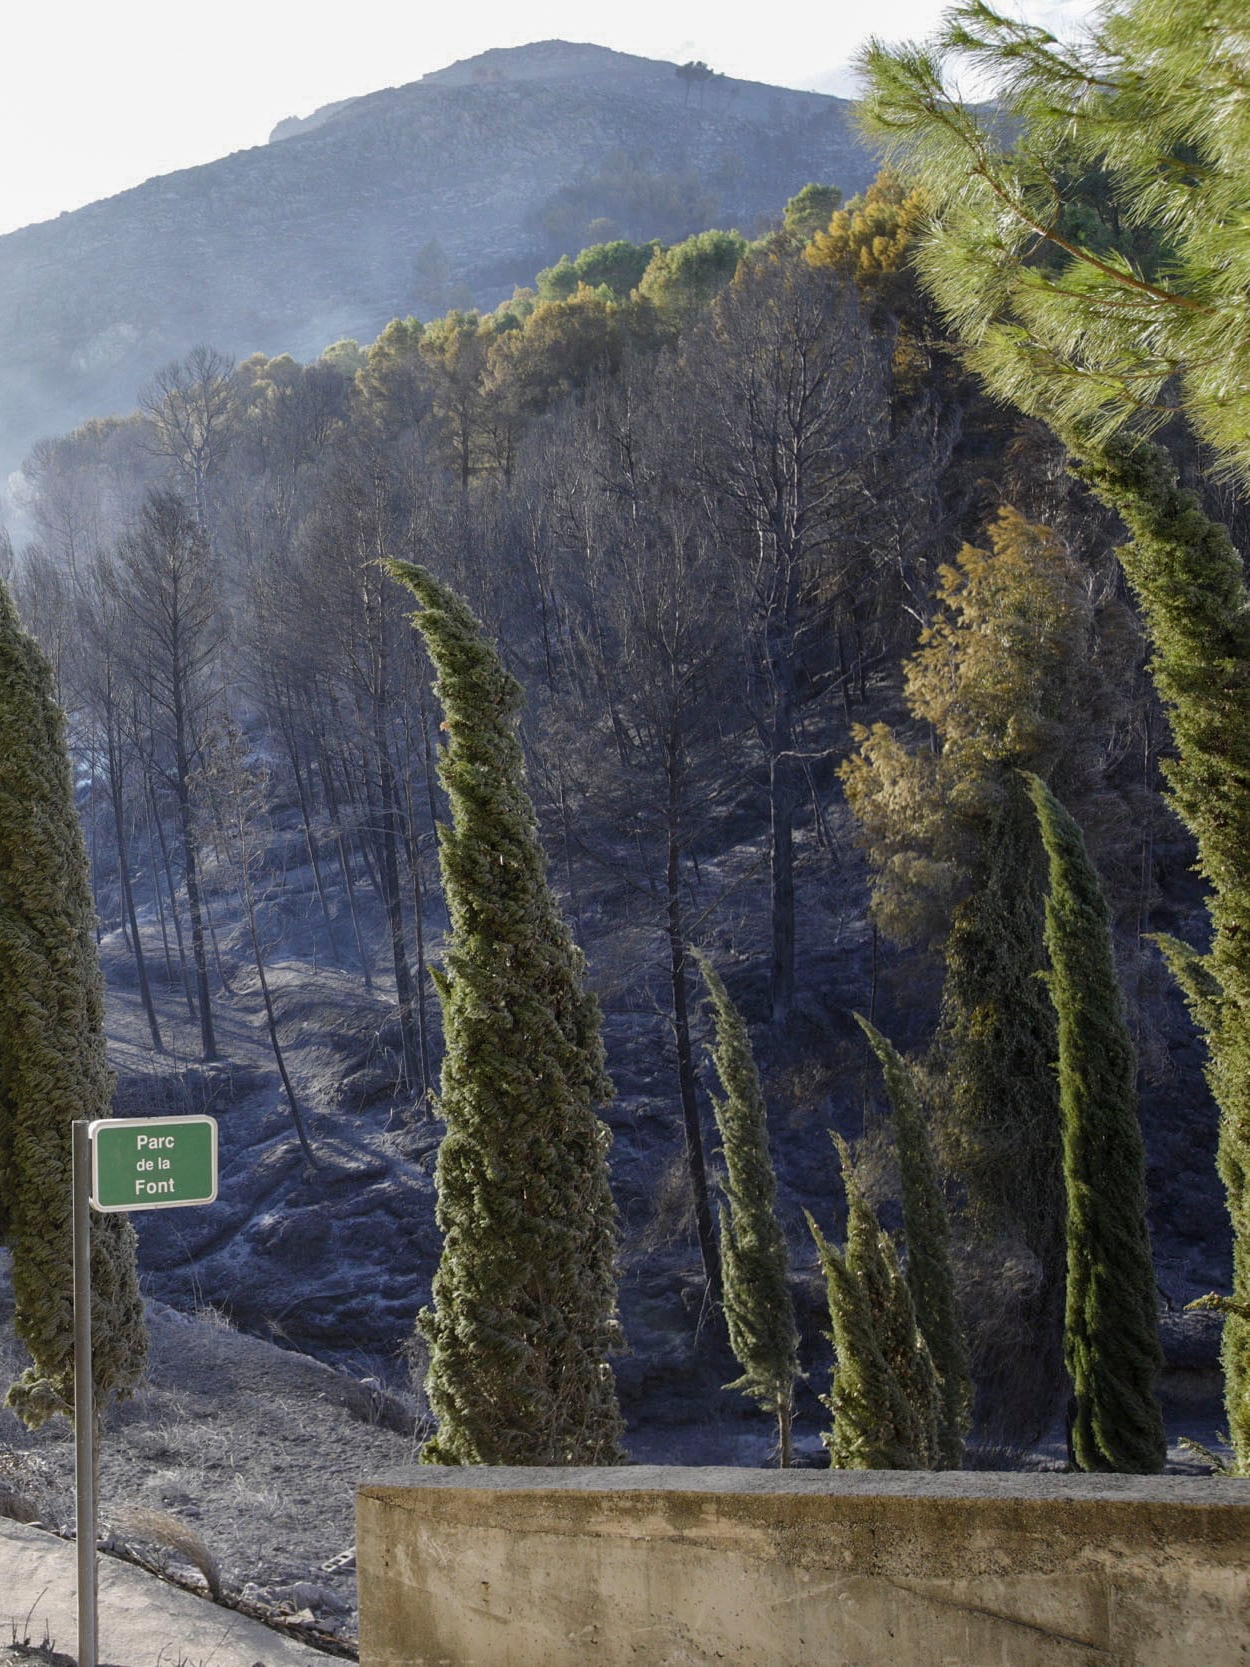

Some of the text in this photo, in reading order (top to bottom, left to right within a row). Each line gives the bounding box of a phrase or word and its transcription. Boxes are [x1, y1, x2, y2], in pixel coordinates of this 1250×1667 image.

[137, 1135, 175, 1150] Parc
[136, 1157, 170, 1171] de la
[135, 1178, 175, 1195] Font
